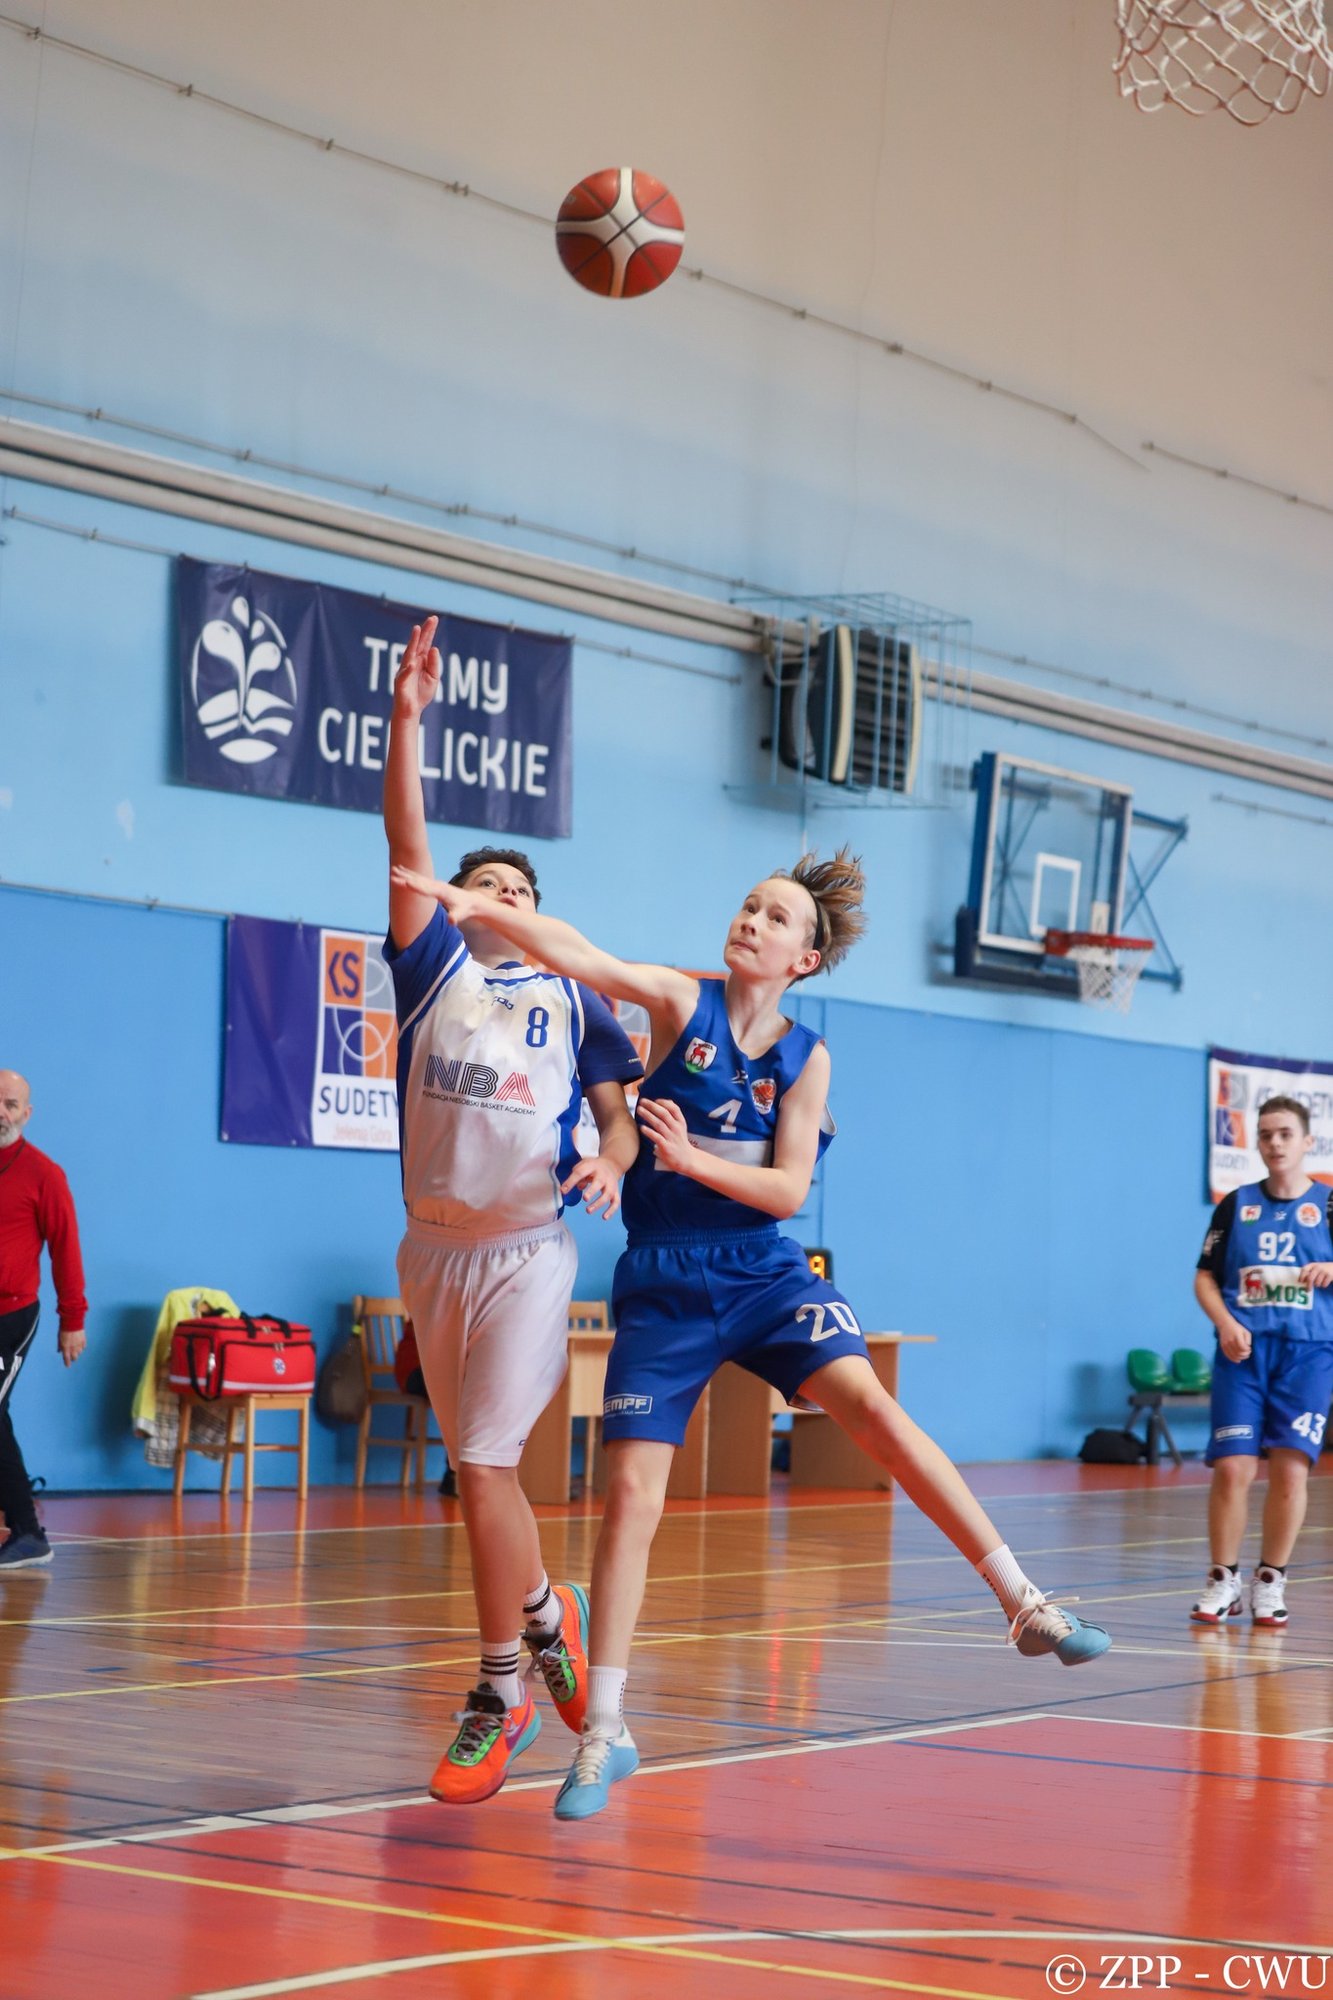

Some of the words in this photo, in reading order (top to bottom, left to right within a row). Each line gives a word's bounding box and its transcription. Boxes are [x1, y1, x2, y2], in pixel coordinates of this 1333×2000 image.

[364, 635, 509, 715] TMY
[318, 707, 549, 797] CIELICKIE
[526, 1006, 549, 1048] 8
[423, 1053, 536, 1107] NBA
[480, 1101, 504, 1112] BASKET
[505, 1105, 536, 1117] ACADEMY
[1258, 1231, 1296, 1262] 92
[1265, 1284, 1309, 1305] MOS
[795, 1301, 861, 1342] 20
[1291, 1411, 1327, 1445] 43
